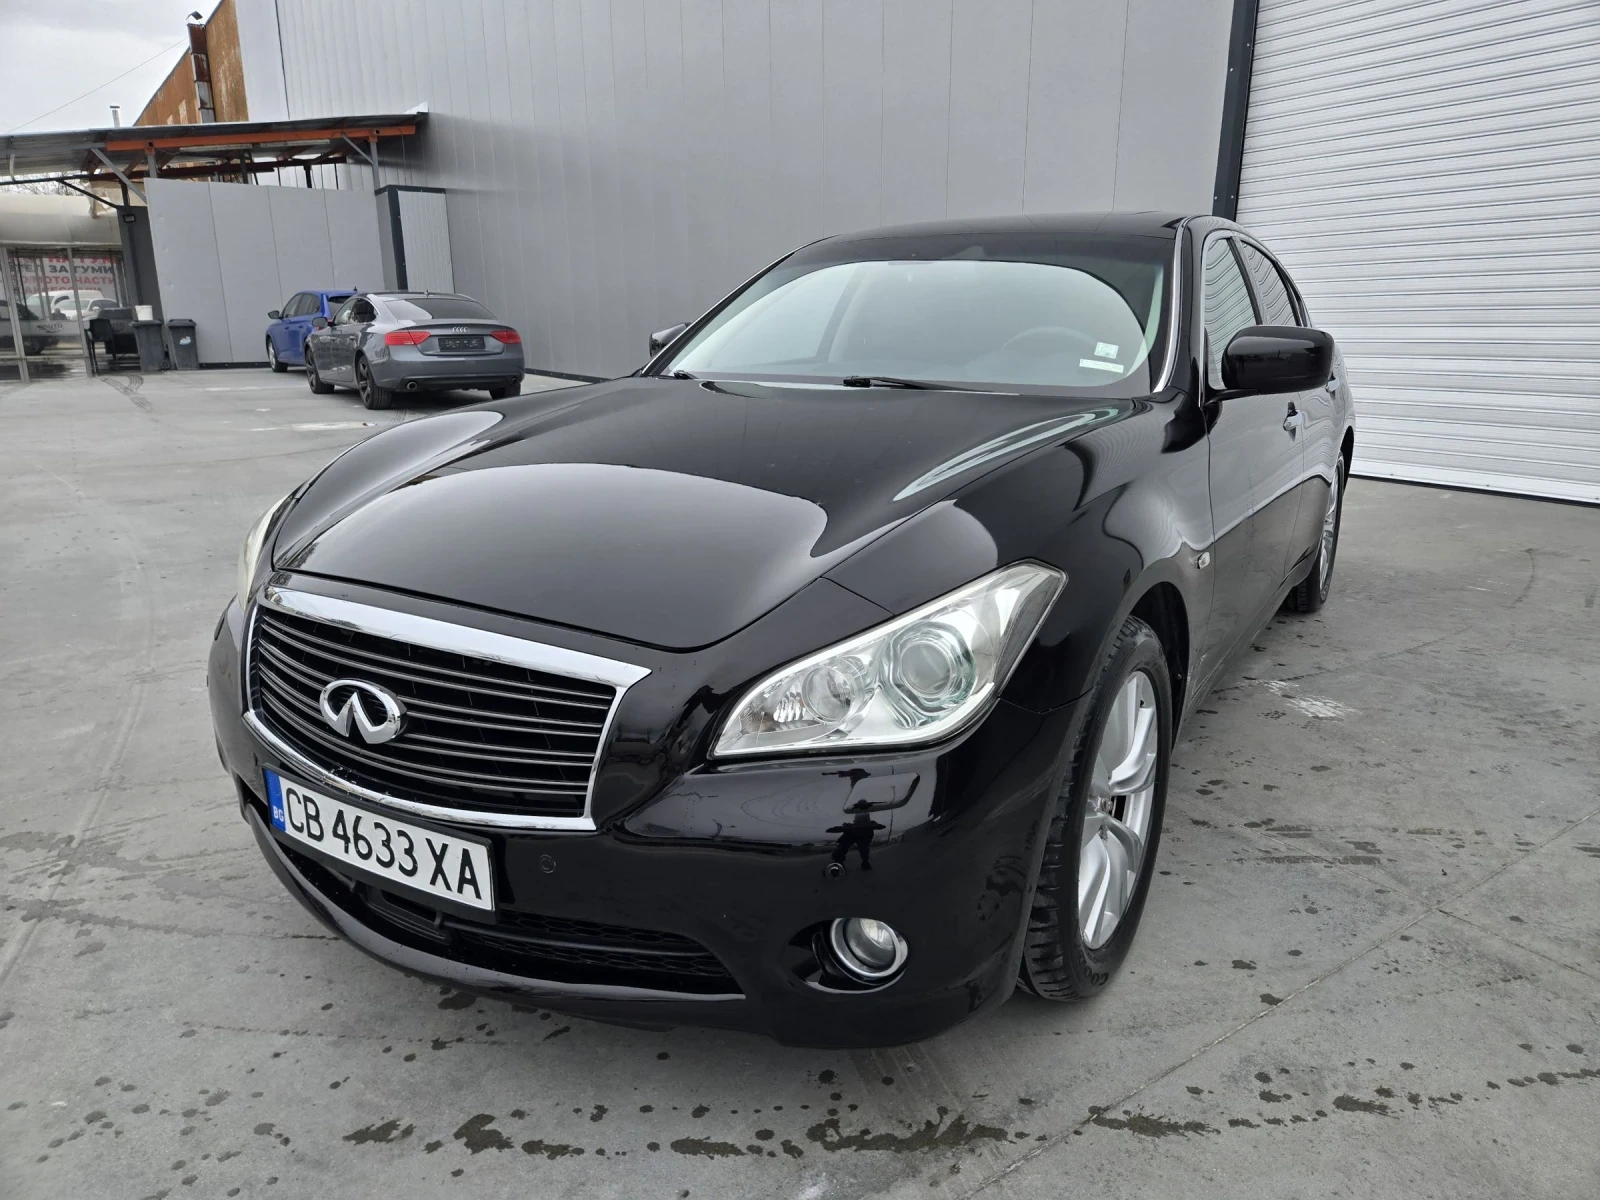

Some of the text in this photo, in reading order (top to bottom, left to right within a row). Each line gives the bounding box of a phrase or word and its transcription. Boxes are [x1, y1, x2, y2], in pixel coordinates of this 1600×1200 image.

[48, 264, 69, 273] ЗА
[273, 805, 285, 823] BG
[285, 787, 483, 901] CB 4633 XA
